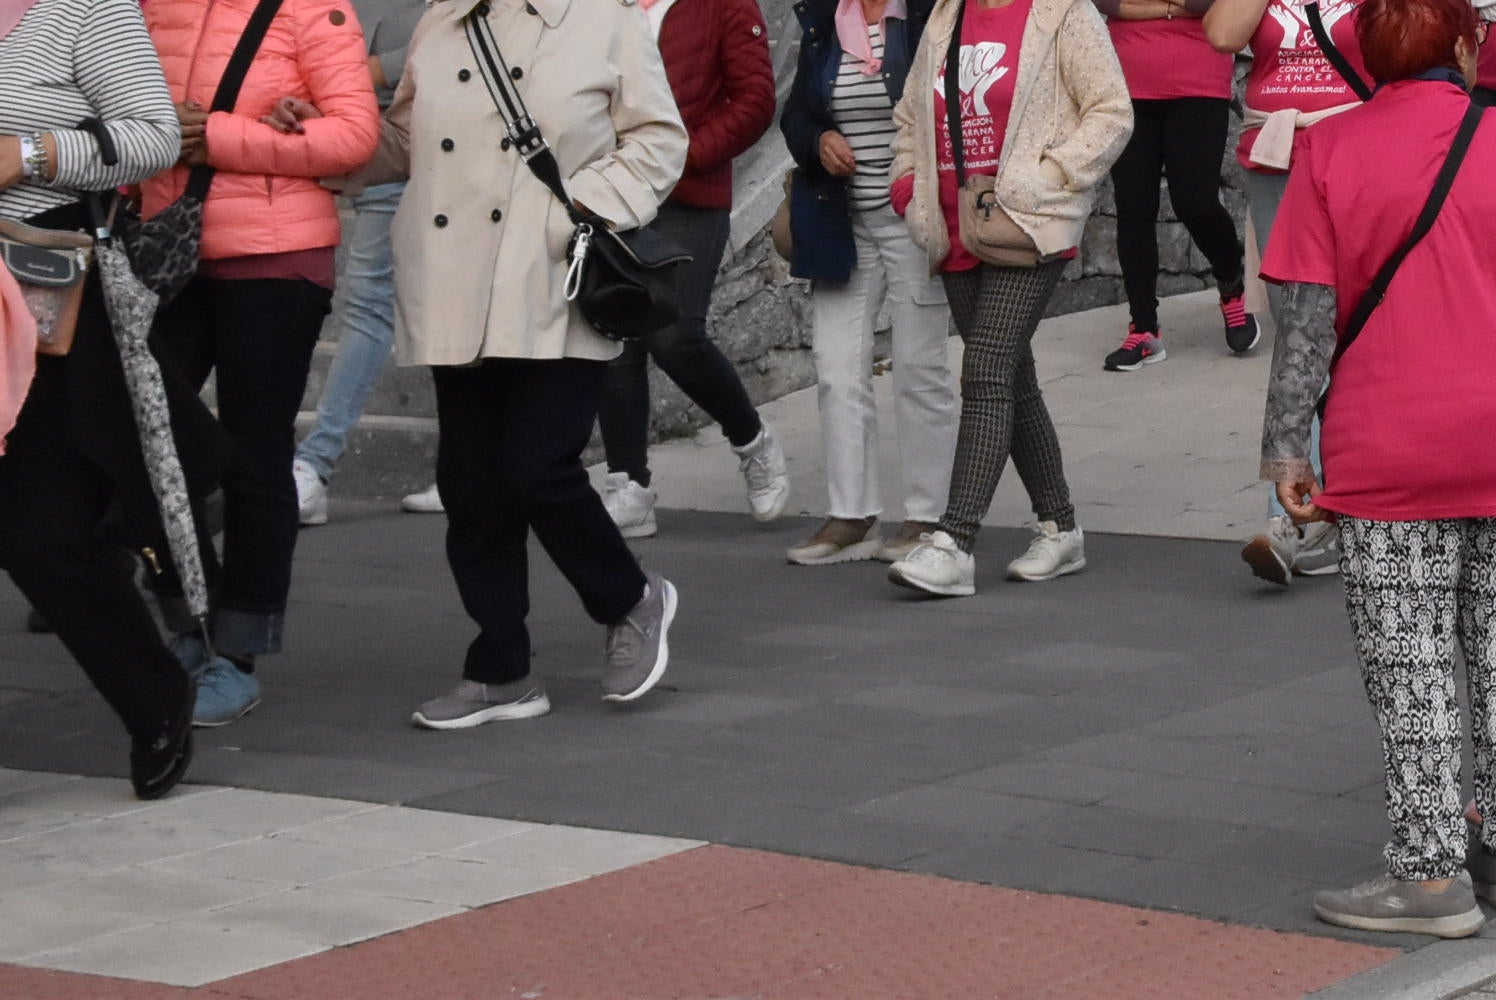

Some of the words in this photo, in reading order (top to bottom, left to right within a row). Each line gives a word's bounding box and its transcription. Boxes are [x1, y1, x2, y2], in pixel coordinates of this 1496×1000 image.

[1278, 49, 1324, 57] ASOCIACI
[1279, 57, 1329, 65] BEJARAN
[1278, 65, 1315, 74] CONTRA
[982, 136, 994, 144] EL
